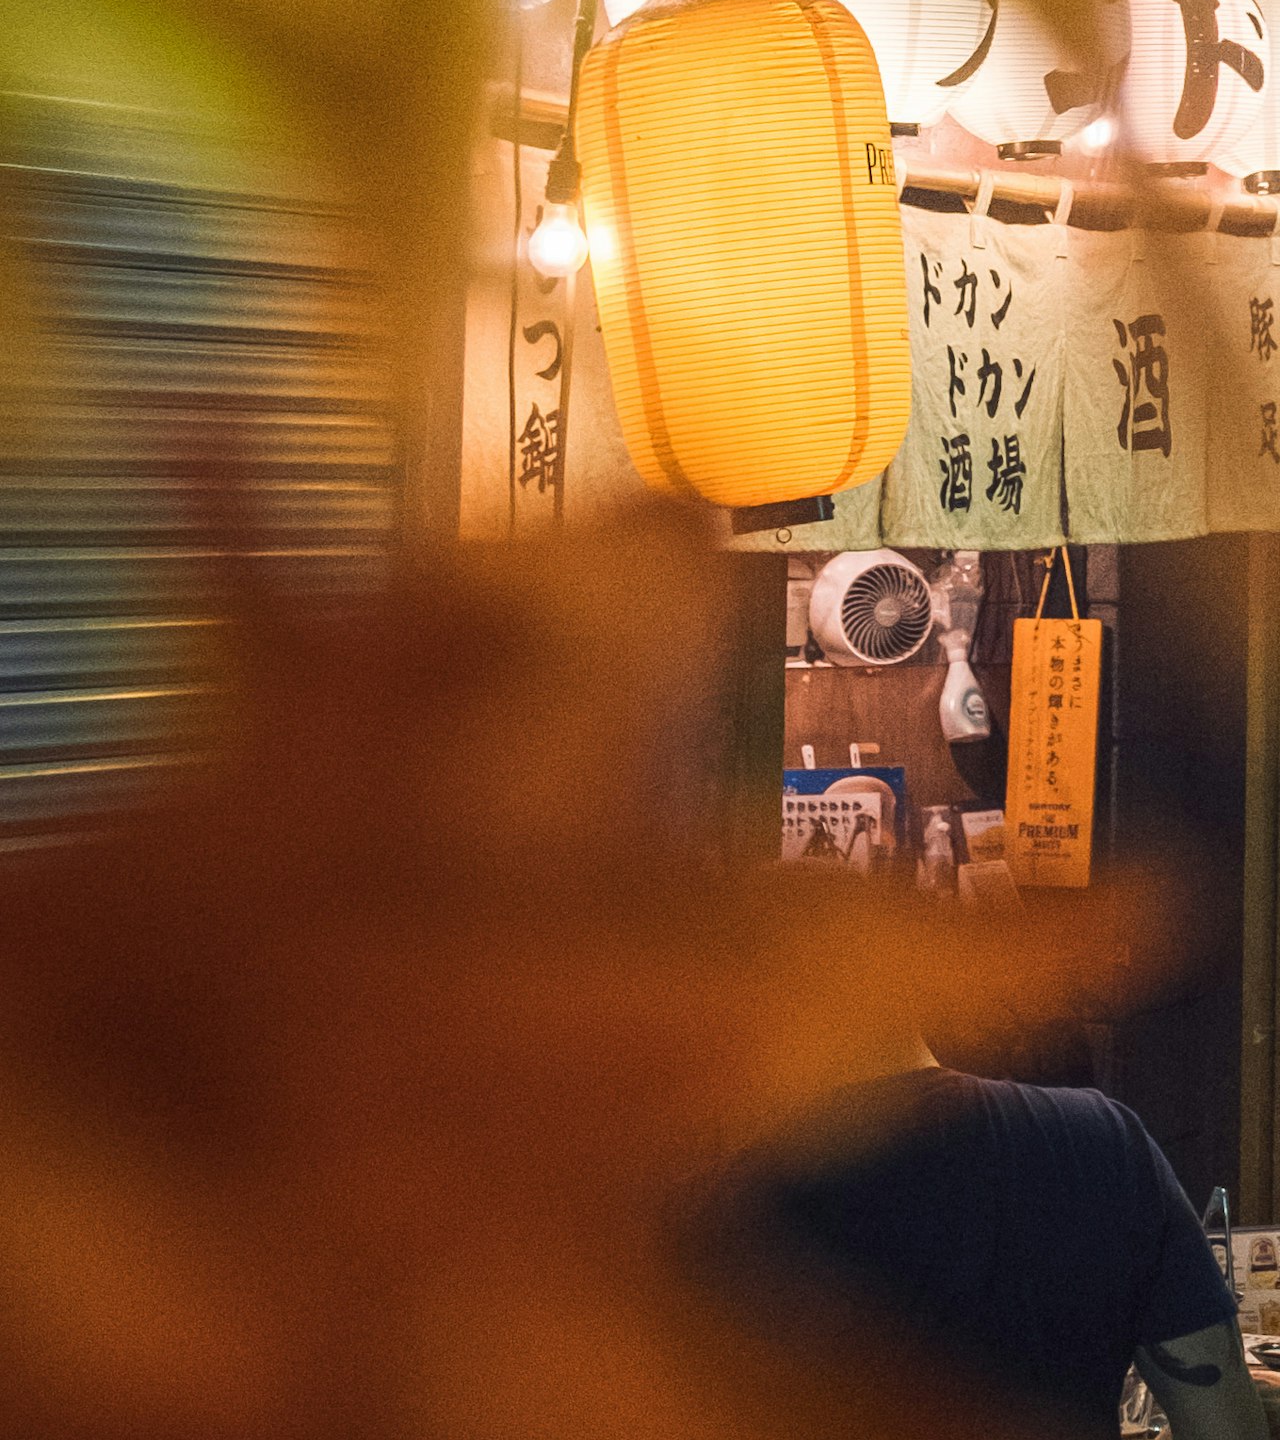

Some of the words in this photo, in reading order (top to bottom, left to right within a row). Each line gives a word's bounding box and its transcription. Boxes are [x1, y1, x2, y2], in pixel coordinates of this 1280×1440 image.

[921, 252, 1013, 330] ドカン
[947, 344, 1037, 419] ドカン
[1112, 313, 1173, 458] 酒
[939, 433, 1027, 515] 酒場
